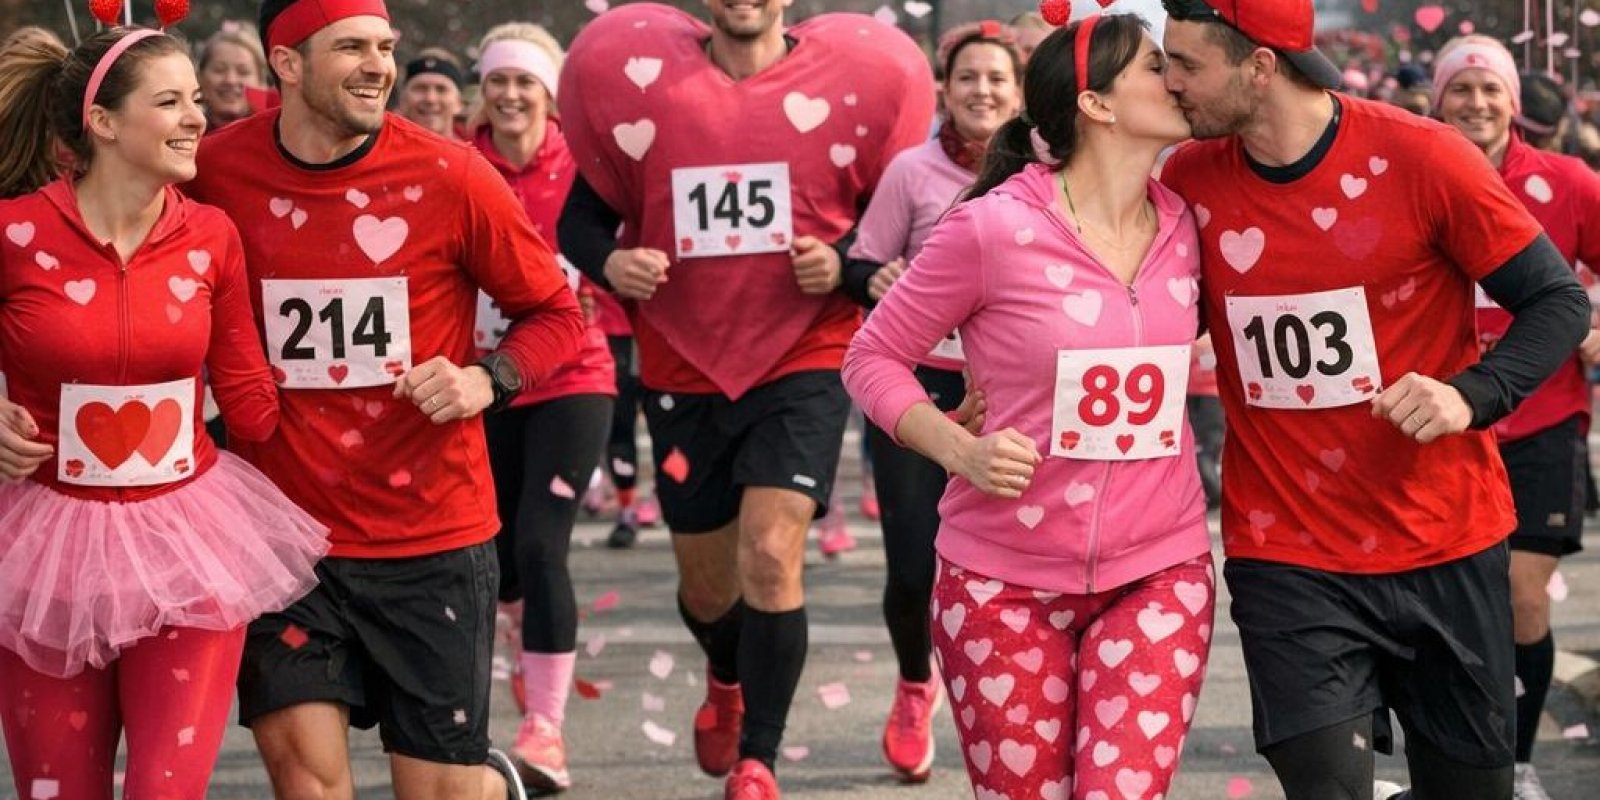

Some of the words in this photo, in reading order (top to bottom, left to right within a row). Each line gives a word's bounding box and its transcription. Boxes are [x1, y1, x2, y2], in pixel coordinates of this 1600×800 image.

[688, 180, 775, 231] 145
[279, 296, 392, 360] 214
[1243, 311, 1353, 379] 103
[1078, 363, 1165, 427] 89
